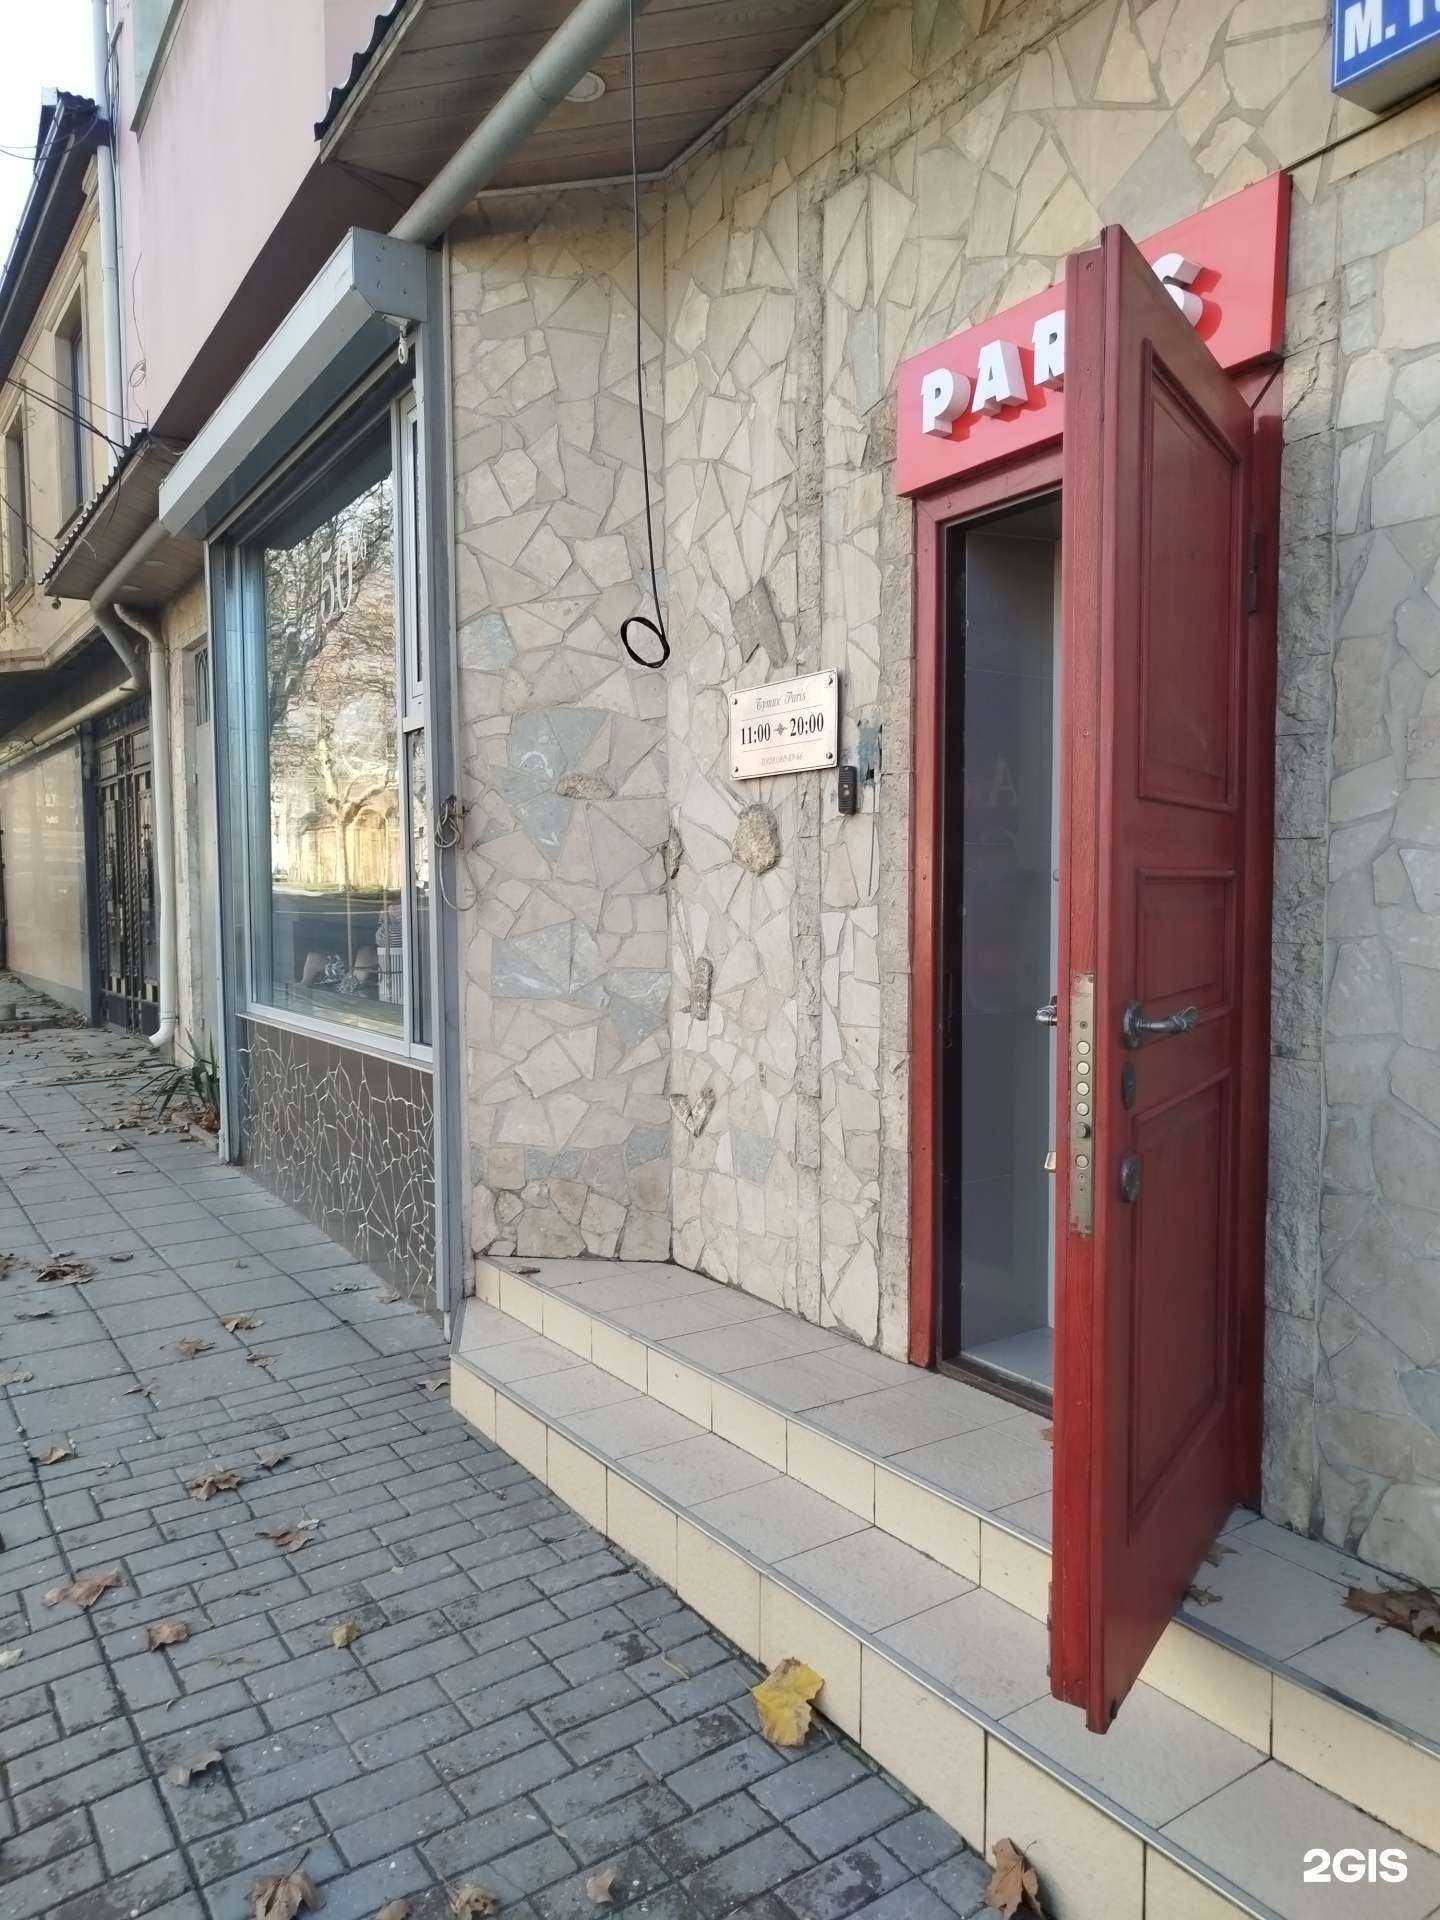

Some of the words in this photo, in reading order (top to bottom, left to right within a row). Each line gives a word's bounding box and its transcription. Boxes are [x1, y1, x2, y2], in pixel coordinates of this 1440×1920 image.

[920, 252, 1203, 438] PARS
[320, 526, 367, 625] 50%
[741, 722, 771, 745] 11:00
[790, 712, 824, 737] 20:00
